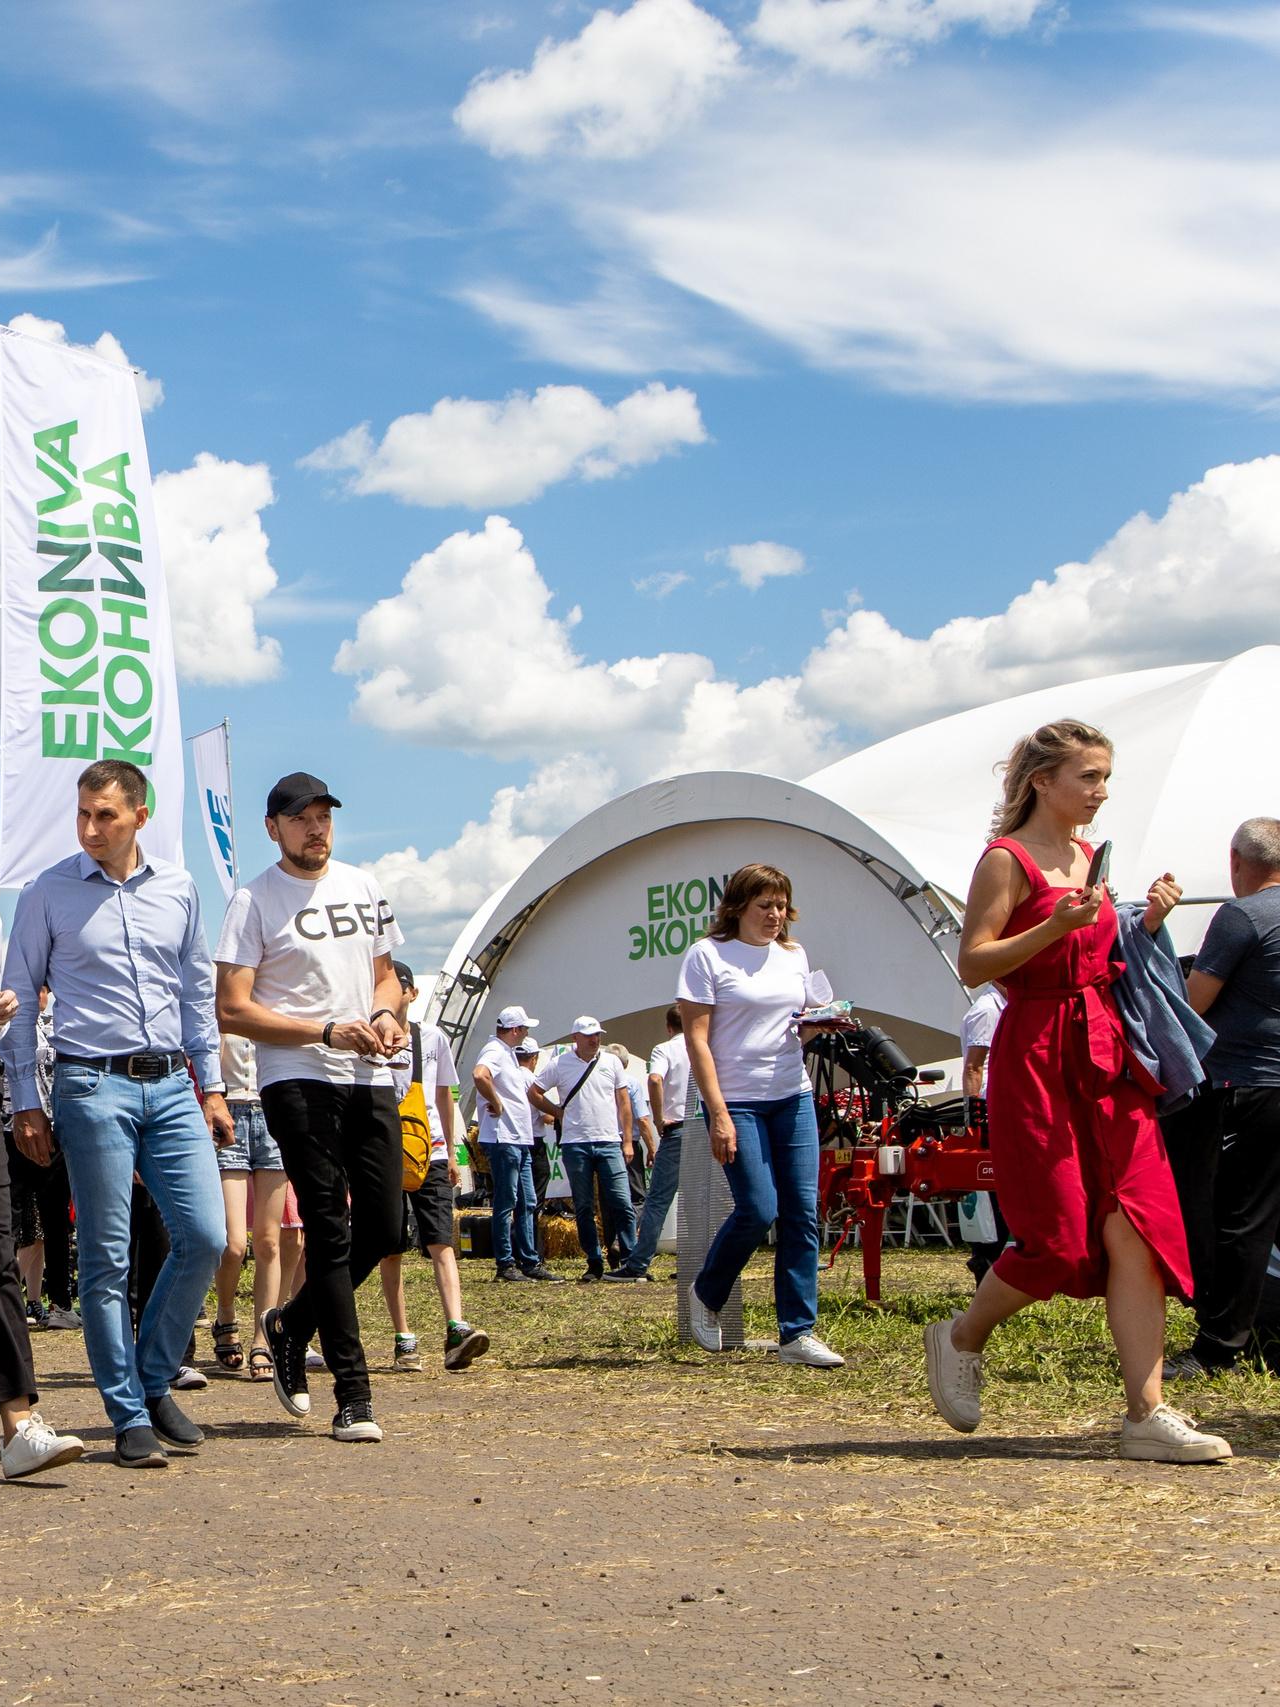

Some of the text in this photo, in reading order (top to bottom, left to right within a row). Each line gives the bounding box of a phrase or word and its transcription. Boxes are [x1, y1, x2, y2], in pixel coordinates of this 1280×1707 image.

[32, 419, 99, 761] EKONIVA
[295, 899, 395, 941] СБЕР
[647, 873, 734, 922] EKON
[628, 915, 717, 961] ЭКОН
